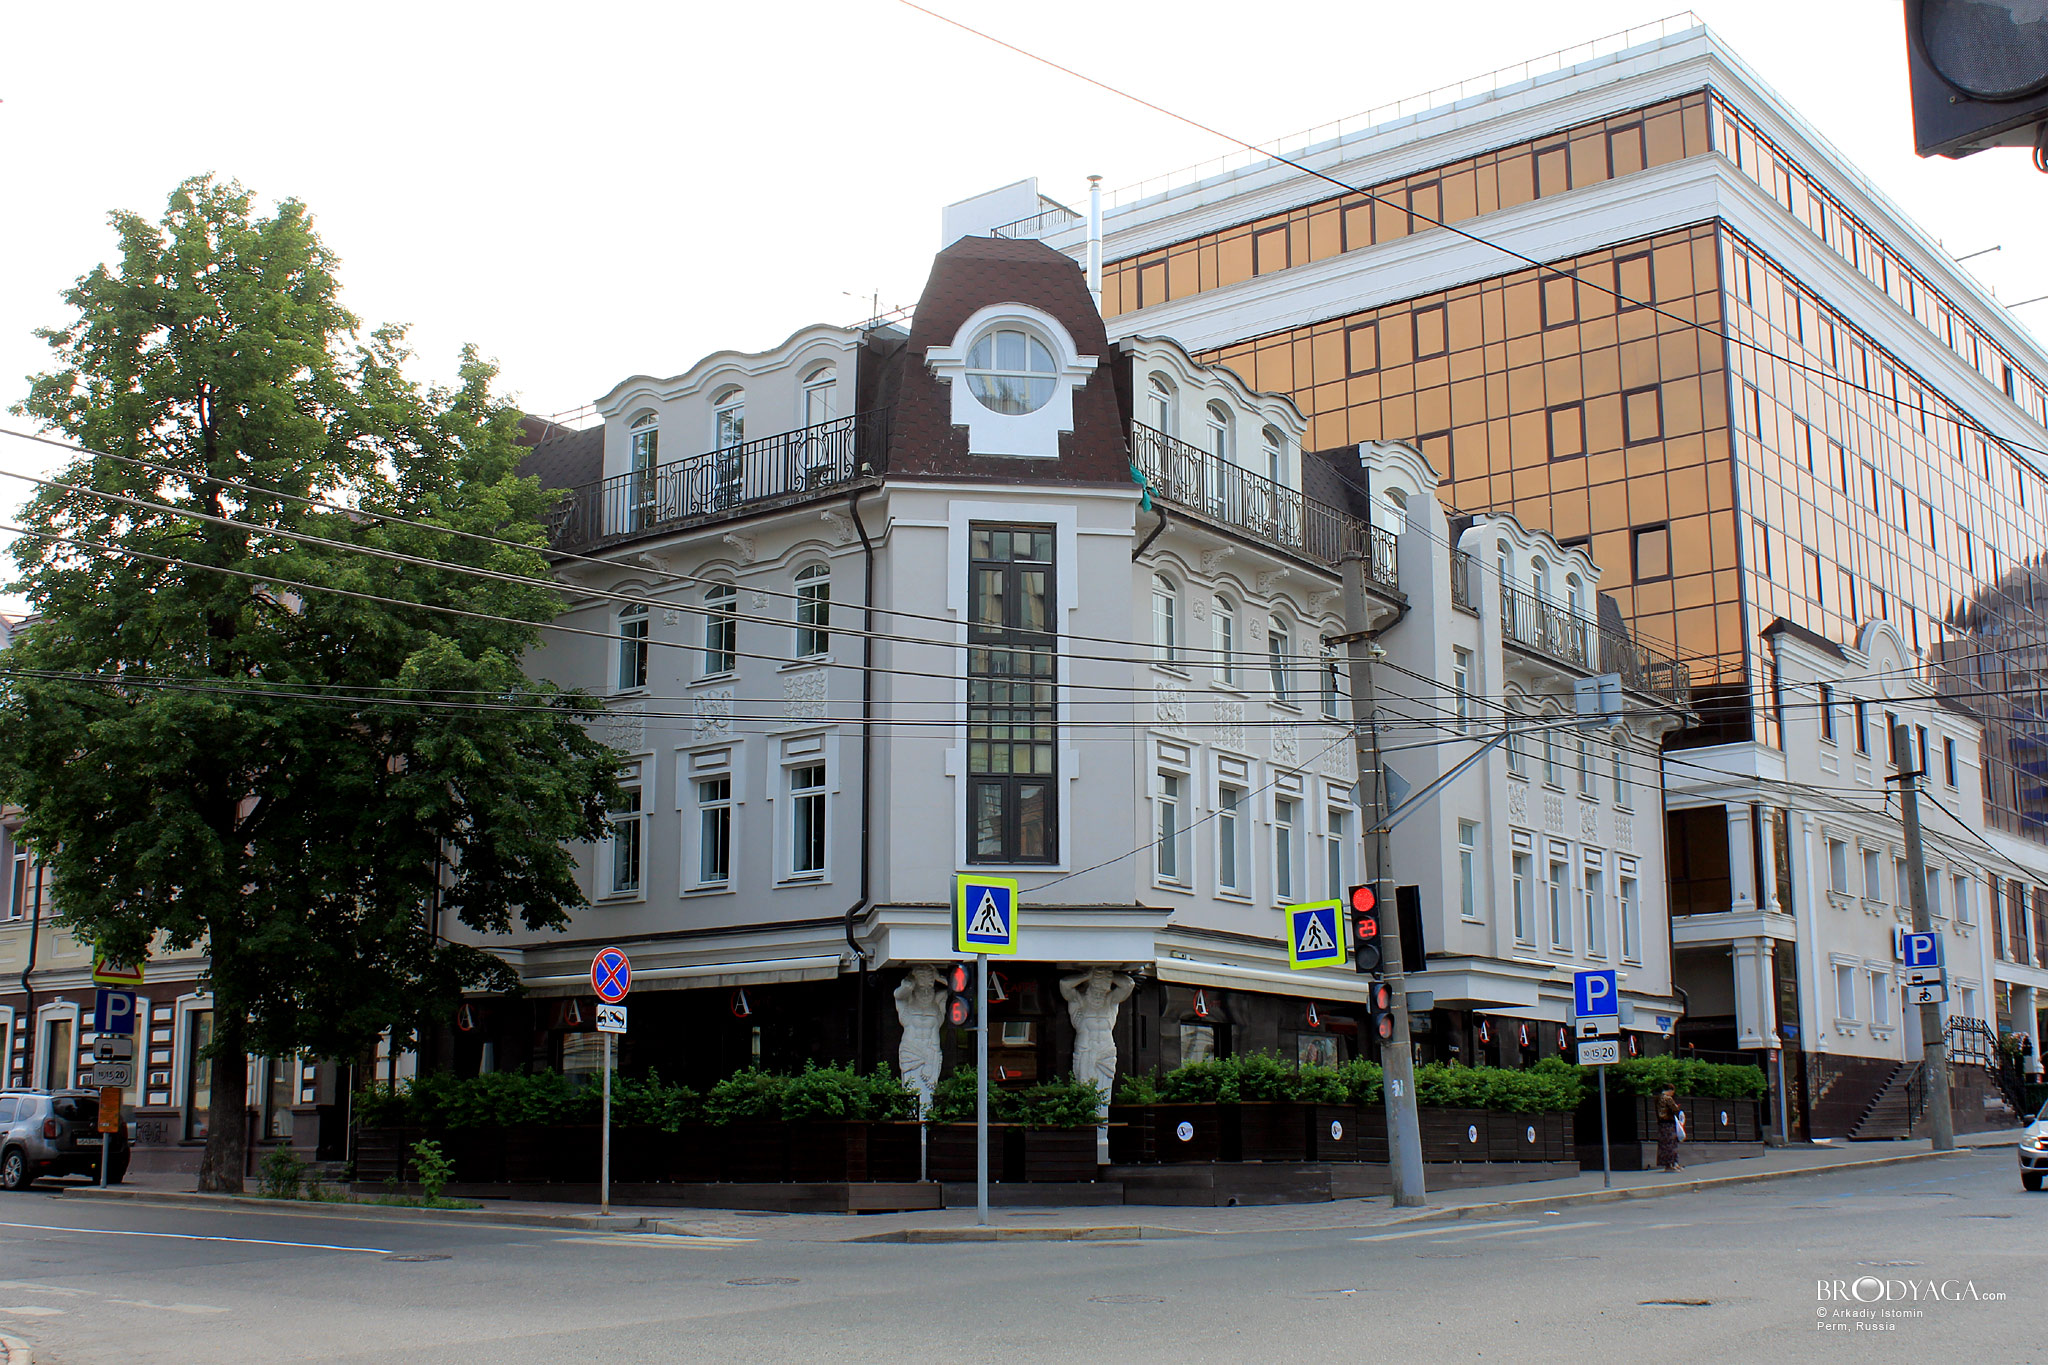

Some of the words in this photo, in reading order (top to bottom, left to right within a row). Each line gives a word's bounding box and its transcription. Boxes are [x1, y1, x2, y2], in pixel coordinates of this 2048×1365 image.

[1358, 919, 1376, 938] 23
[1912, 935, 1932, 965] P
[1585, 975, 1609, 1012] P
[105, 993, 131, 1031] P
[1592, 1049, 1600, 1058] 15
[1602, 1047, 1614, 1057] 20
[115, 1070, 125, 1079] 20
